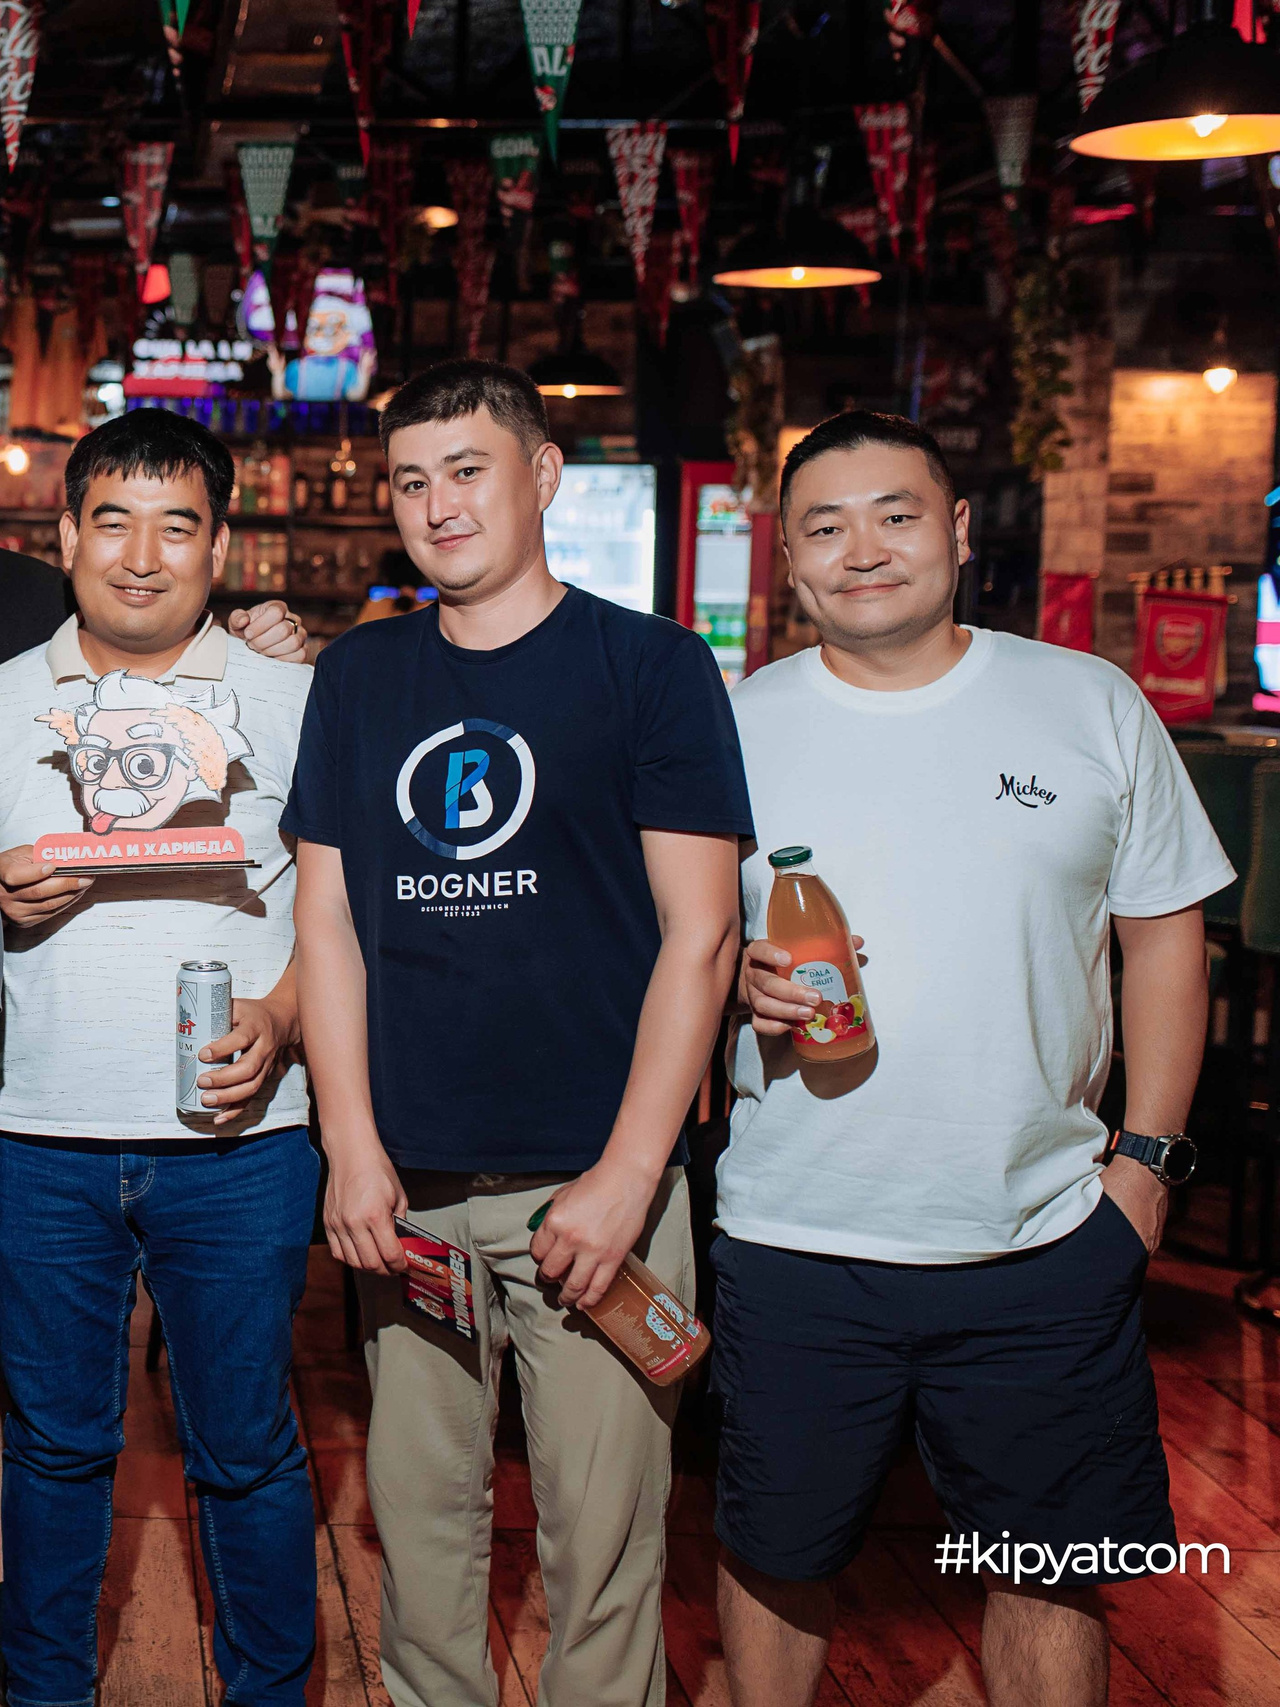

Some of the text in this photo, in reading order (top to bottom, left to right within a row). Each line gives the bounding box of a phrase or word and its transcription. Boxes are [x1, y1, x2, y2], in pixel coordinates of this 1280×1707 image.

[995, 773, 1057, 808] Mickey
[41, 840, 236, 862] СЦИЛЛА И ХАРИБДА
[396, 869, 538, 900] BOGNER
[809, 968, 831, 978] DALA
[811, 976, 834, 987] FRUIT
